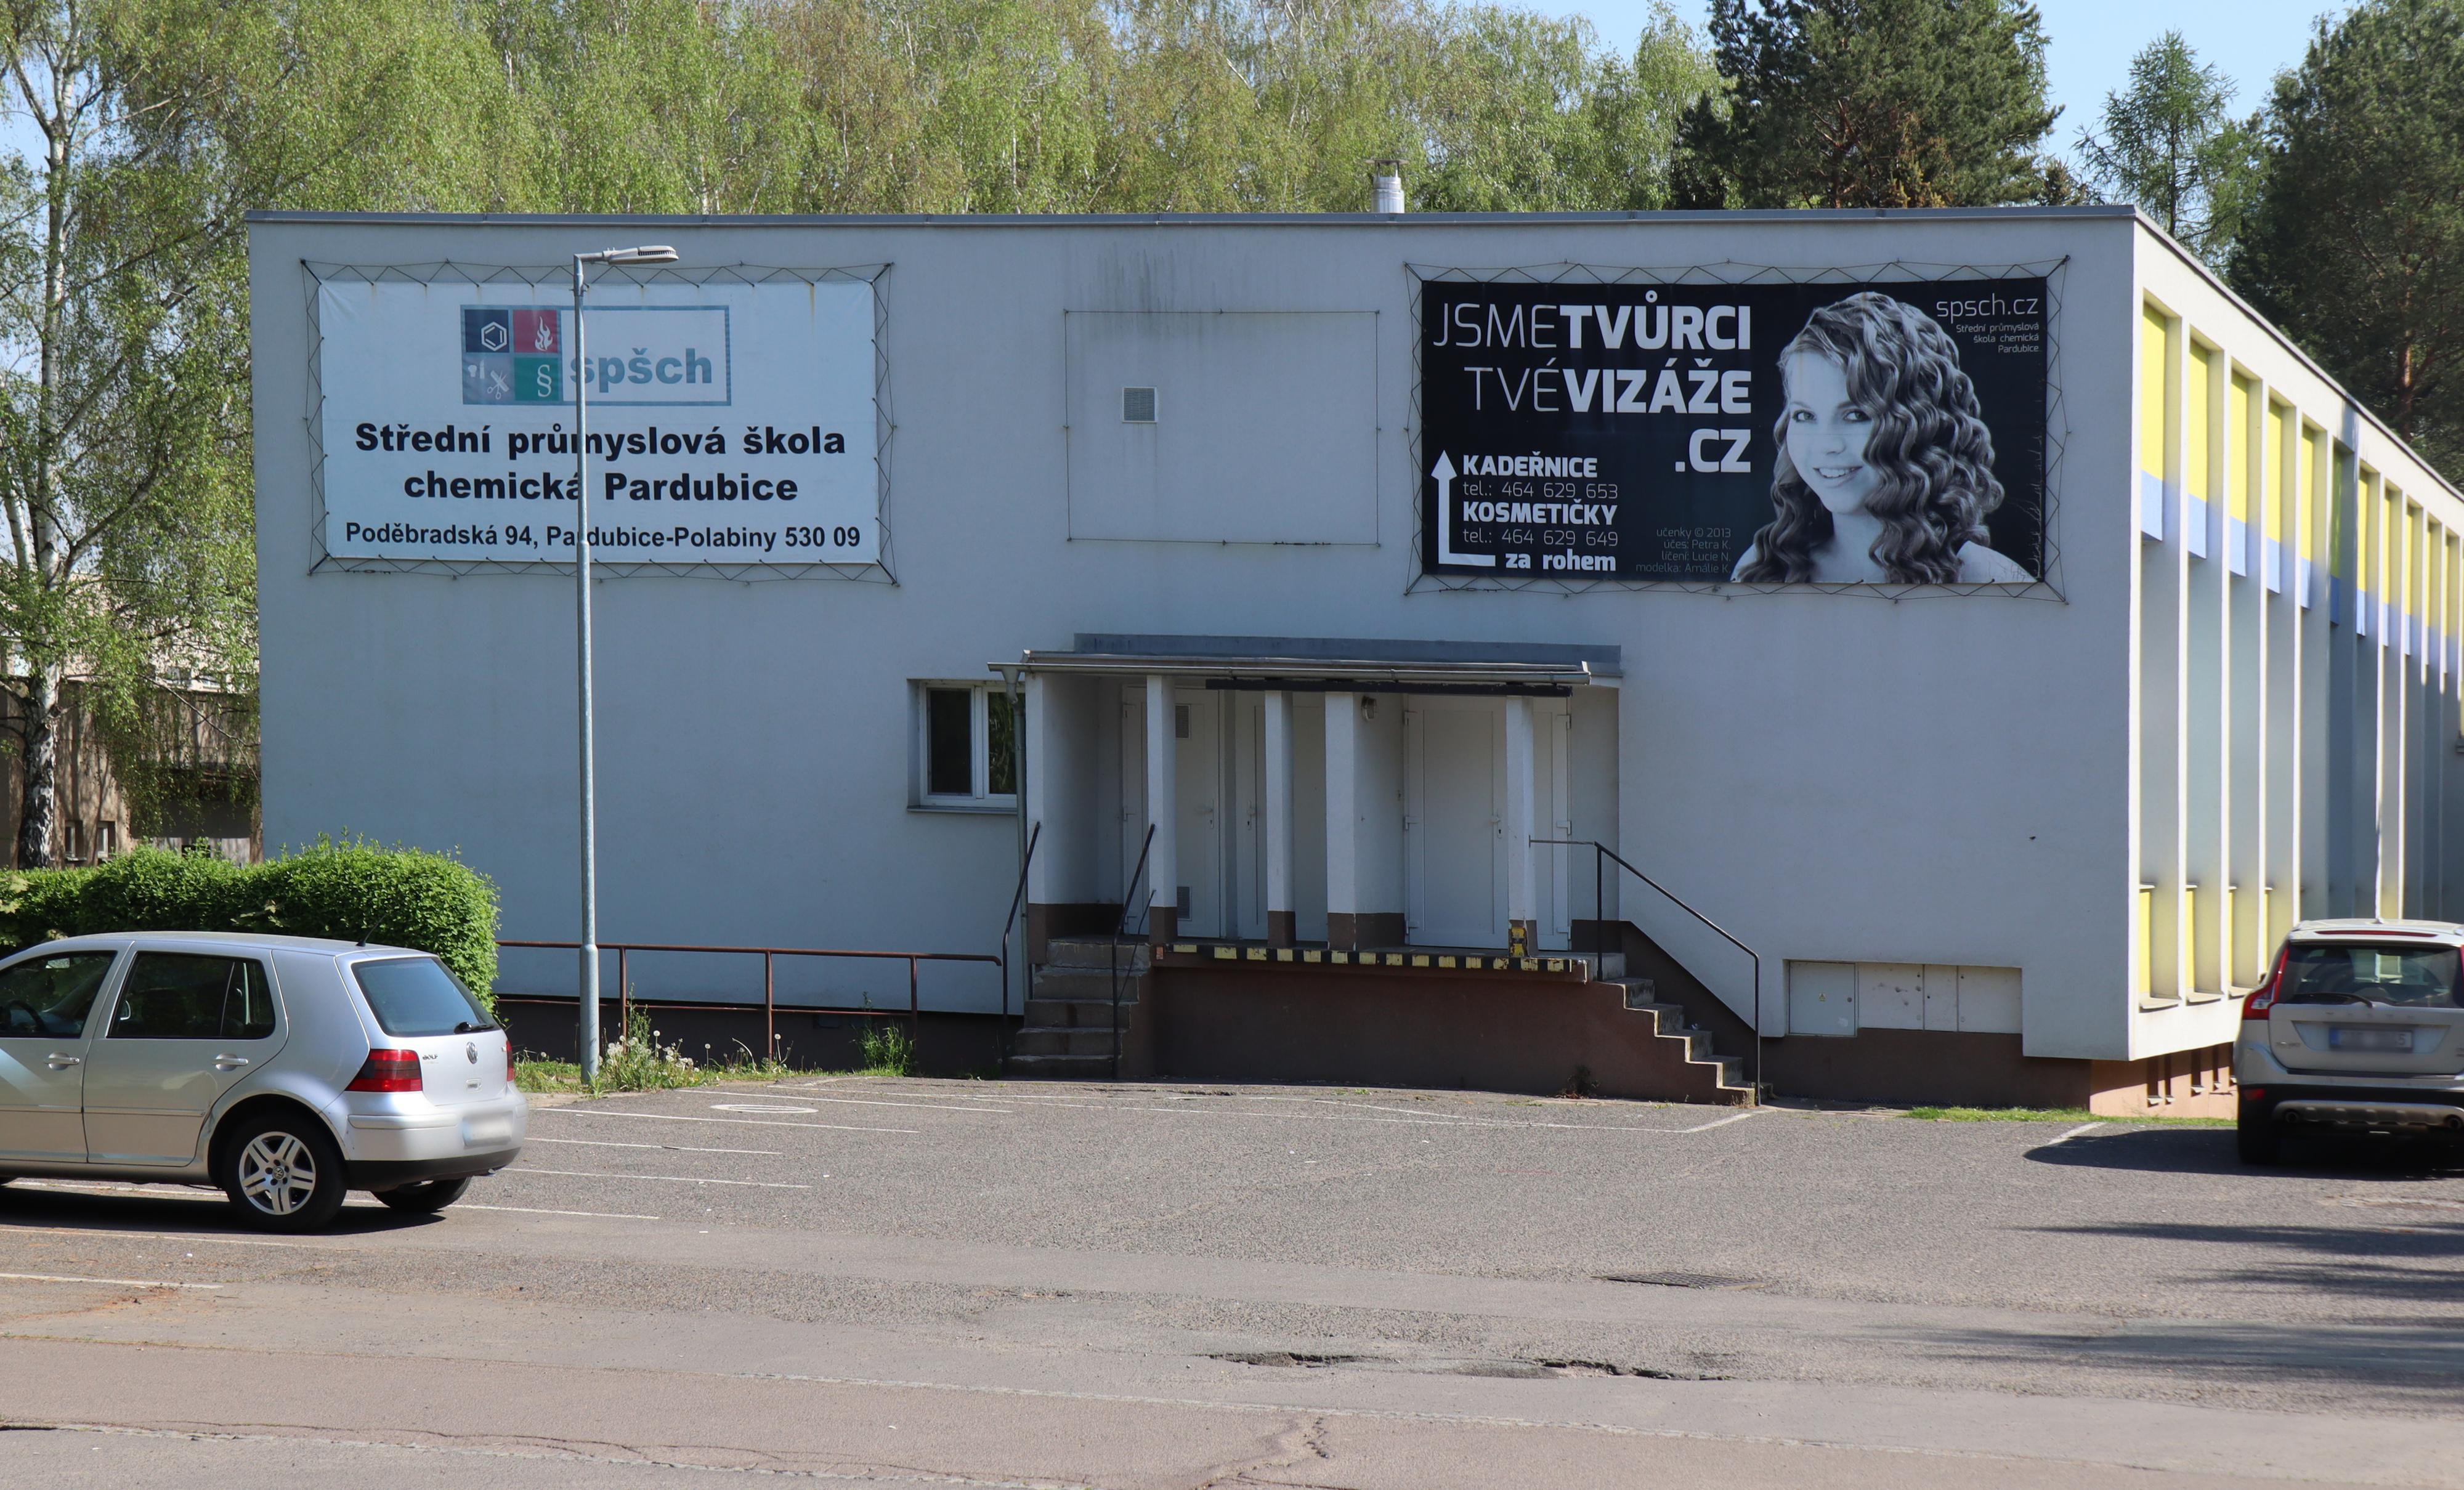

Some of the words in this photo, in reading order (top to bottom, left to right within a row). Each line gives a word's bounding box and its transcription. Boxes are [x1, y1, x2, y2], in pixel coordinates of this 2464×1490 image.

[1936, 293, 2039, 324] spsch.cz
[1956, 324, 1986, 333] Střední
[1990, 322, 2040, 334] průmyslová
[1974, 334, 1996, 343] škola
[2000, 333, 2040, 342] chemická
[1998, 344, 2040, 354] Pardubice
[570, 347, 712, 393] spšch
[355, 422, 490, 453] Střední
[508, 423, 726, 461] průmyslová
[743, 426, 846, 455] škola
[1674, 428, 1751, 473] .CZ
[1462, 450, 1598, 478] KADEŘNICE
[605, 472, 798, 501] Pardubice
[1462, 480, 1492, 496] tel.:
[1502, 482, 1534, 497] 464
[1543, 482, 1576, 498] 629
[1586, 484, 1618, 500] 653
[1462, 498, 1618, 525] KOSMETIČKY
[346, 522, 498, 546] Poděbradská
[505, 525, 538, 549] 94,
[546, 525, 777, 553] Padubice-Polabiny
[785, 526, 825, 548] 530
[833, 526, 861, 548] 09
[1462, 527, 1492, 543] tel.:
[1502, 528, 1534, 545] 464
[1543, 530, 1576, 545] 629
[1586, 531, 1618, 546] 649
[1656, 527, 1692, 540] učenky
[1706, 528, 1732, 538] 2013
[1664, 539, 1689, 549] účes:
[1692, 540, 1720, 549] Petra
[1722, 540, 1732, 549] K.
[1506, 553, 1531, 569] za
[1542, 548, 1616, 572] rohem
[1661, 550, 1689, 561] líčení:
[1692, 551, 1718, 561] Lucie
[1721, 552, 1732, 561] N.
[1635, 562, 1681, 573] modelka:
[1684, 563, 1719, 573] Amálie
[1722, 564, 1731, 573] K.
